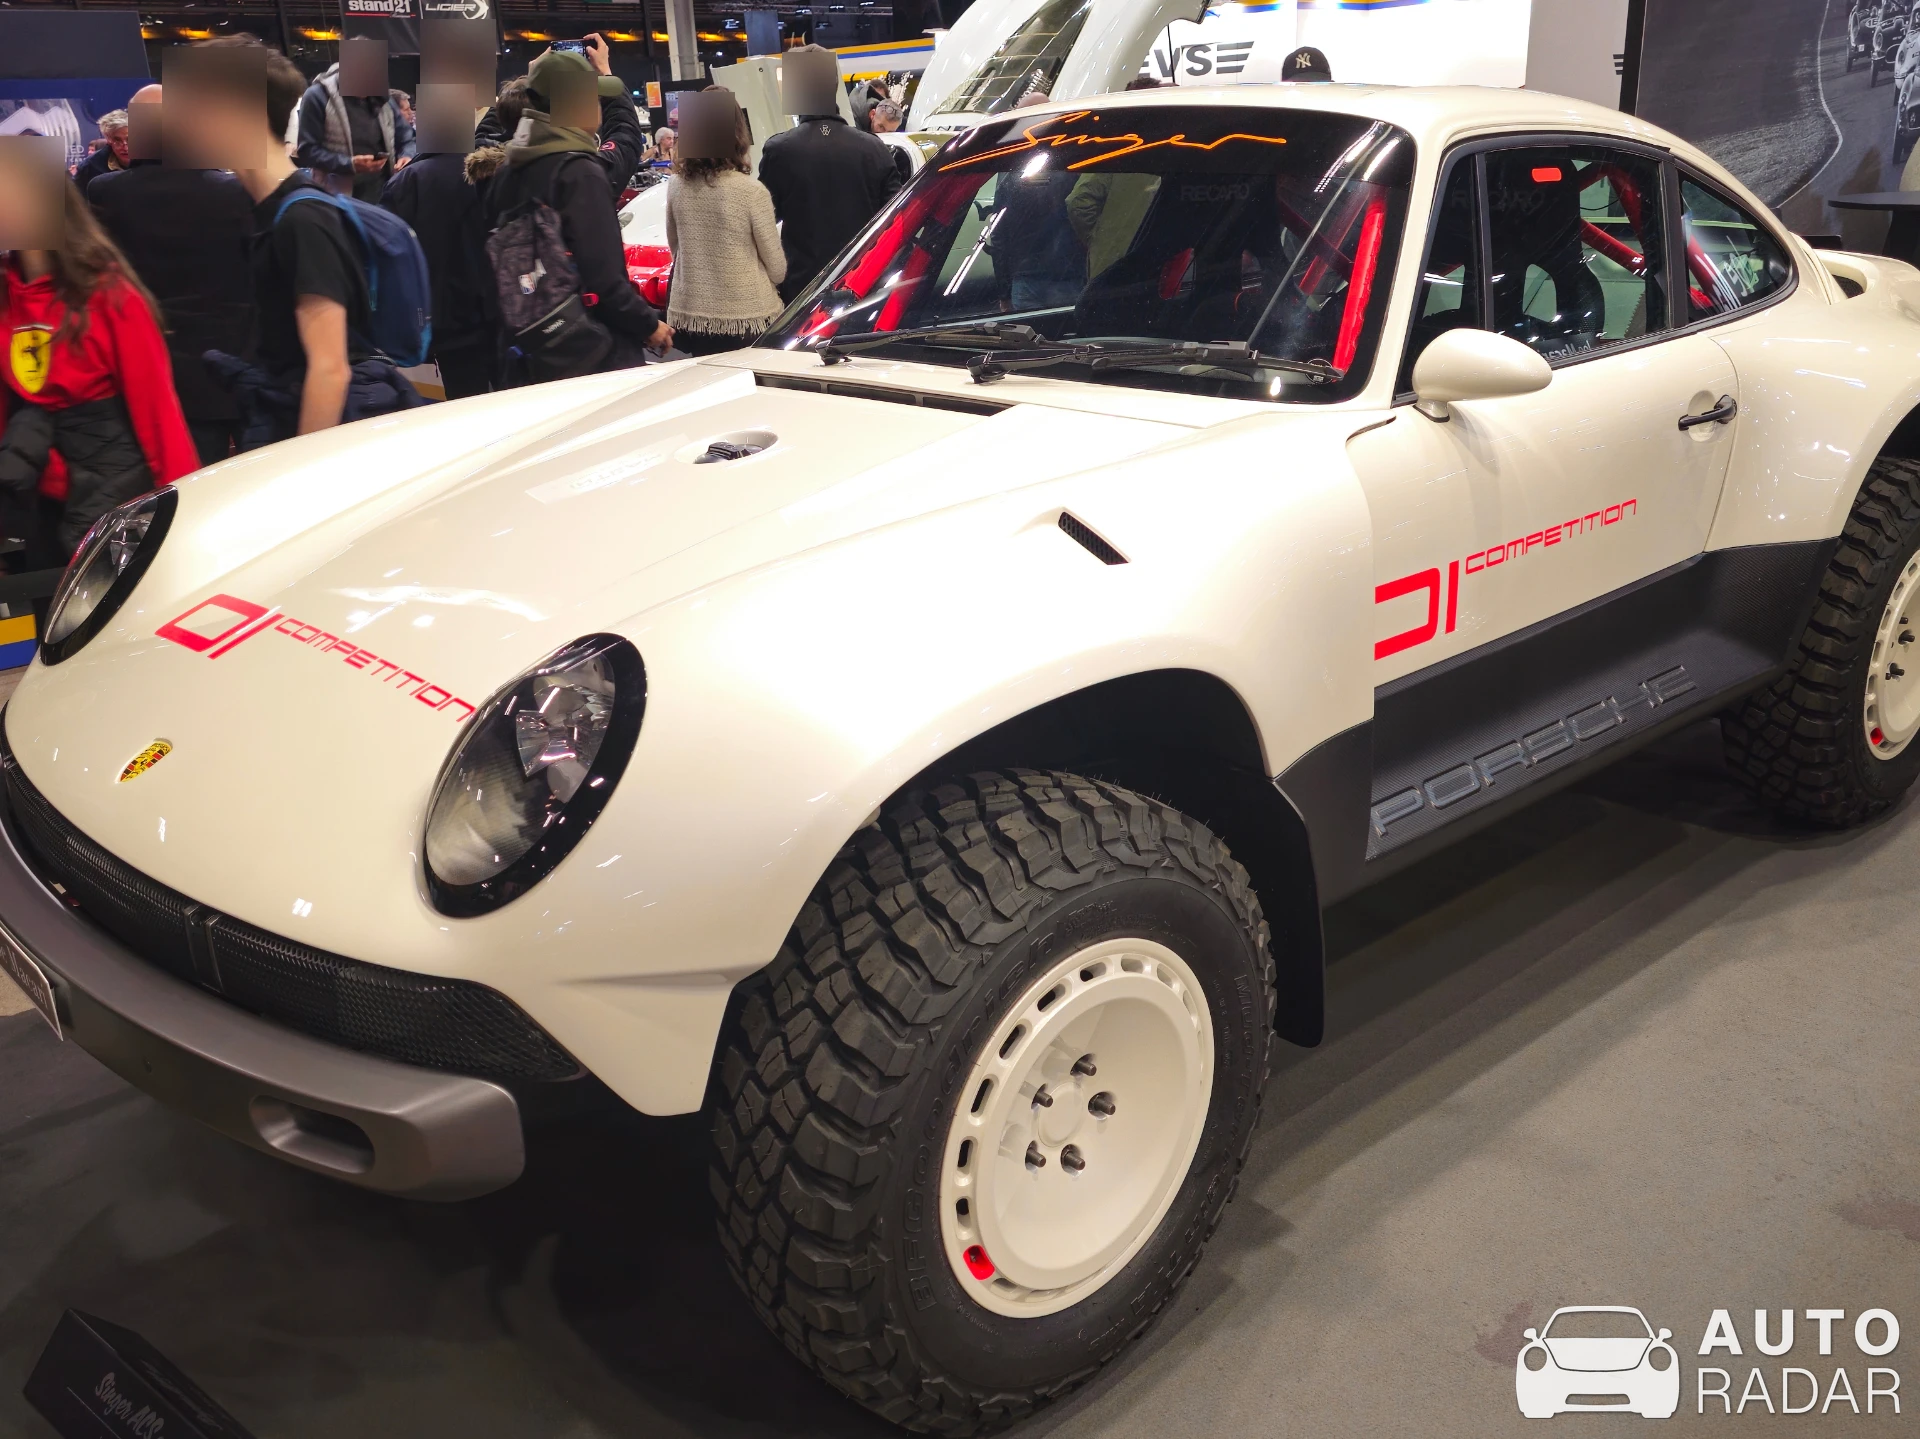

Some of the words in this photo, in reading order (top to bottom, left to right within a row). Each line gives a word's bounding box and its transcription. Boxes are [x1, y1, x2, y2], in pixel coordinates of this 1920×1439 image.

[425, 3, 477, 11] LIGIER
[1295, 53, 1312, 69] NY
[937, 110, 1287, 172] Singer
[1180, 183, 1250, 201] RECARO
[1465, 498, 1638, 576] COMPETITION
[273, 618, 477, 724] COMPETITION
[1371, 664, 1697, 839] PORSCHE
[95, 1371, 134, 1421] Singer
